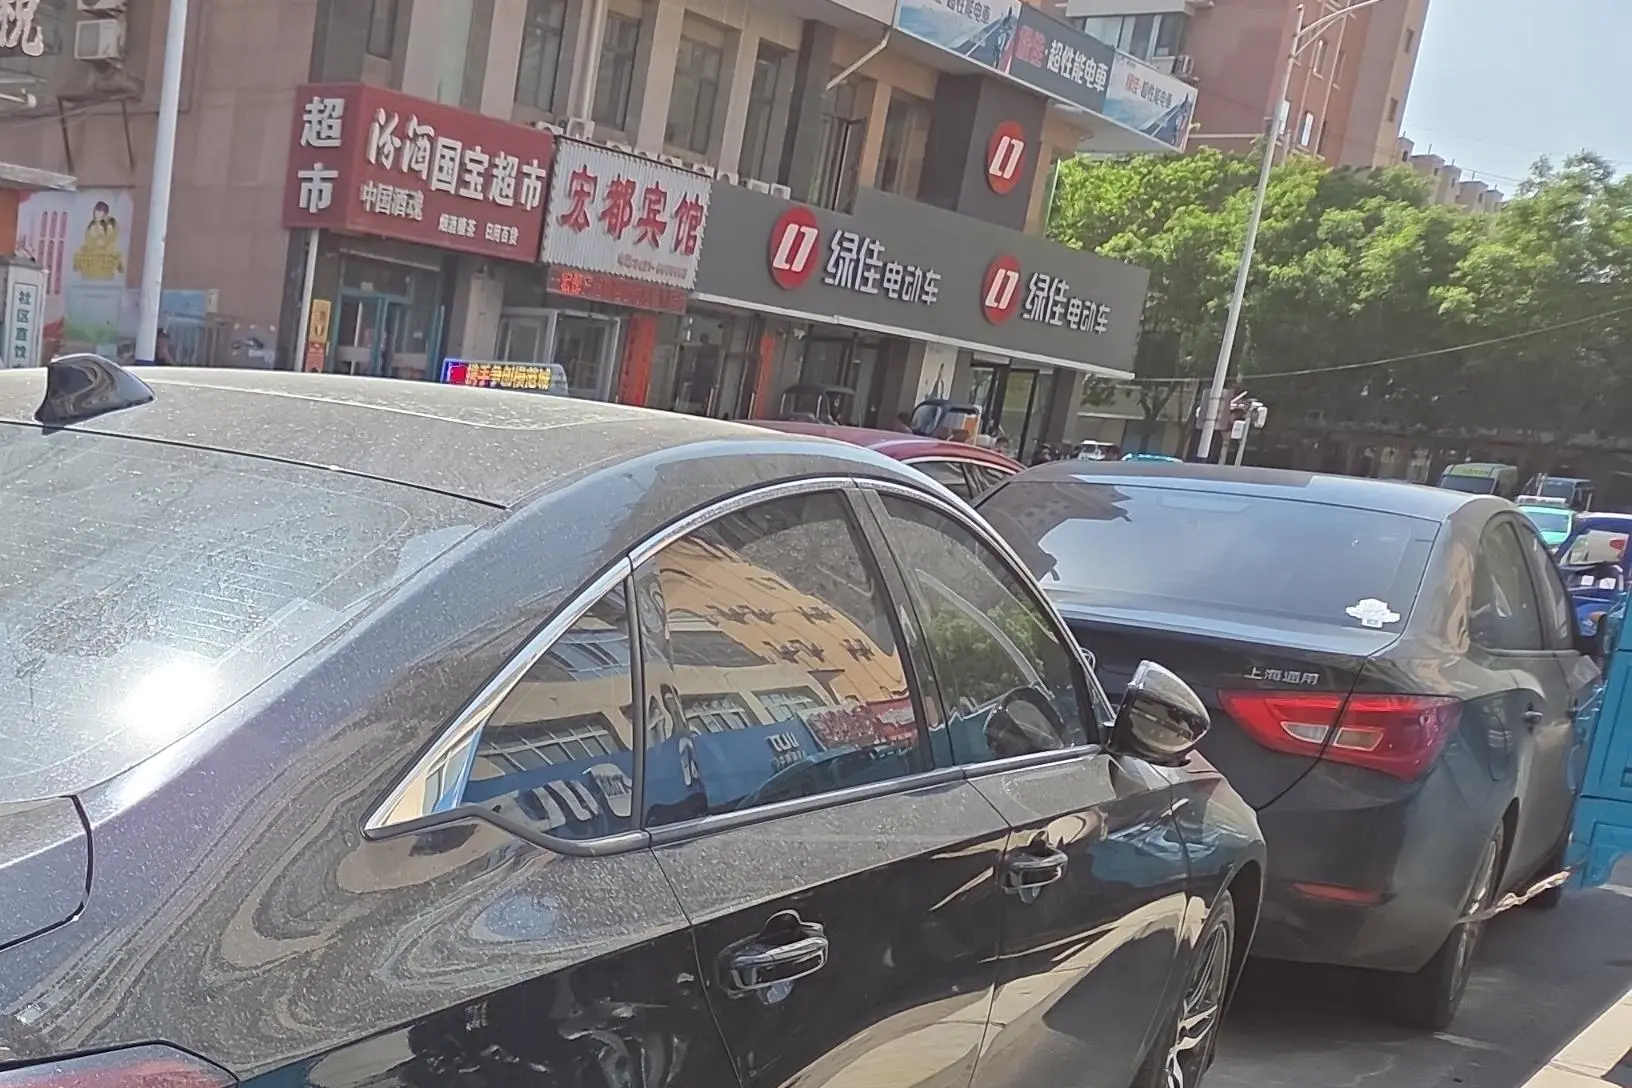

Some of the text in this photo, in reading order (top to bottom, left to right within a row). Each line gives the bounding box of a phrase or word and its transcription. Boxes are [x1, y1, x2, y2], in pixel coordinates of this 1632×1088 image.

[297, 96, 345, 214] 超市
[560, 164, 705, 257] 宏都宾馆
[824, 228, 943, 306] 绿佳电动车
[1022, 271, 1111, 335] 绿佳电动车
[13, 291, 32, 368] 社区直饮
[1243, 666, 1320, 685] 上海通用
